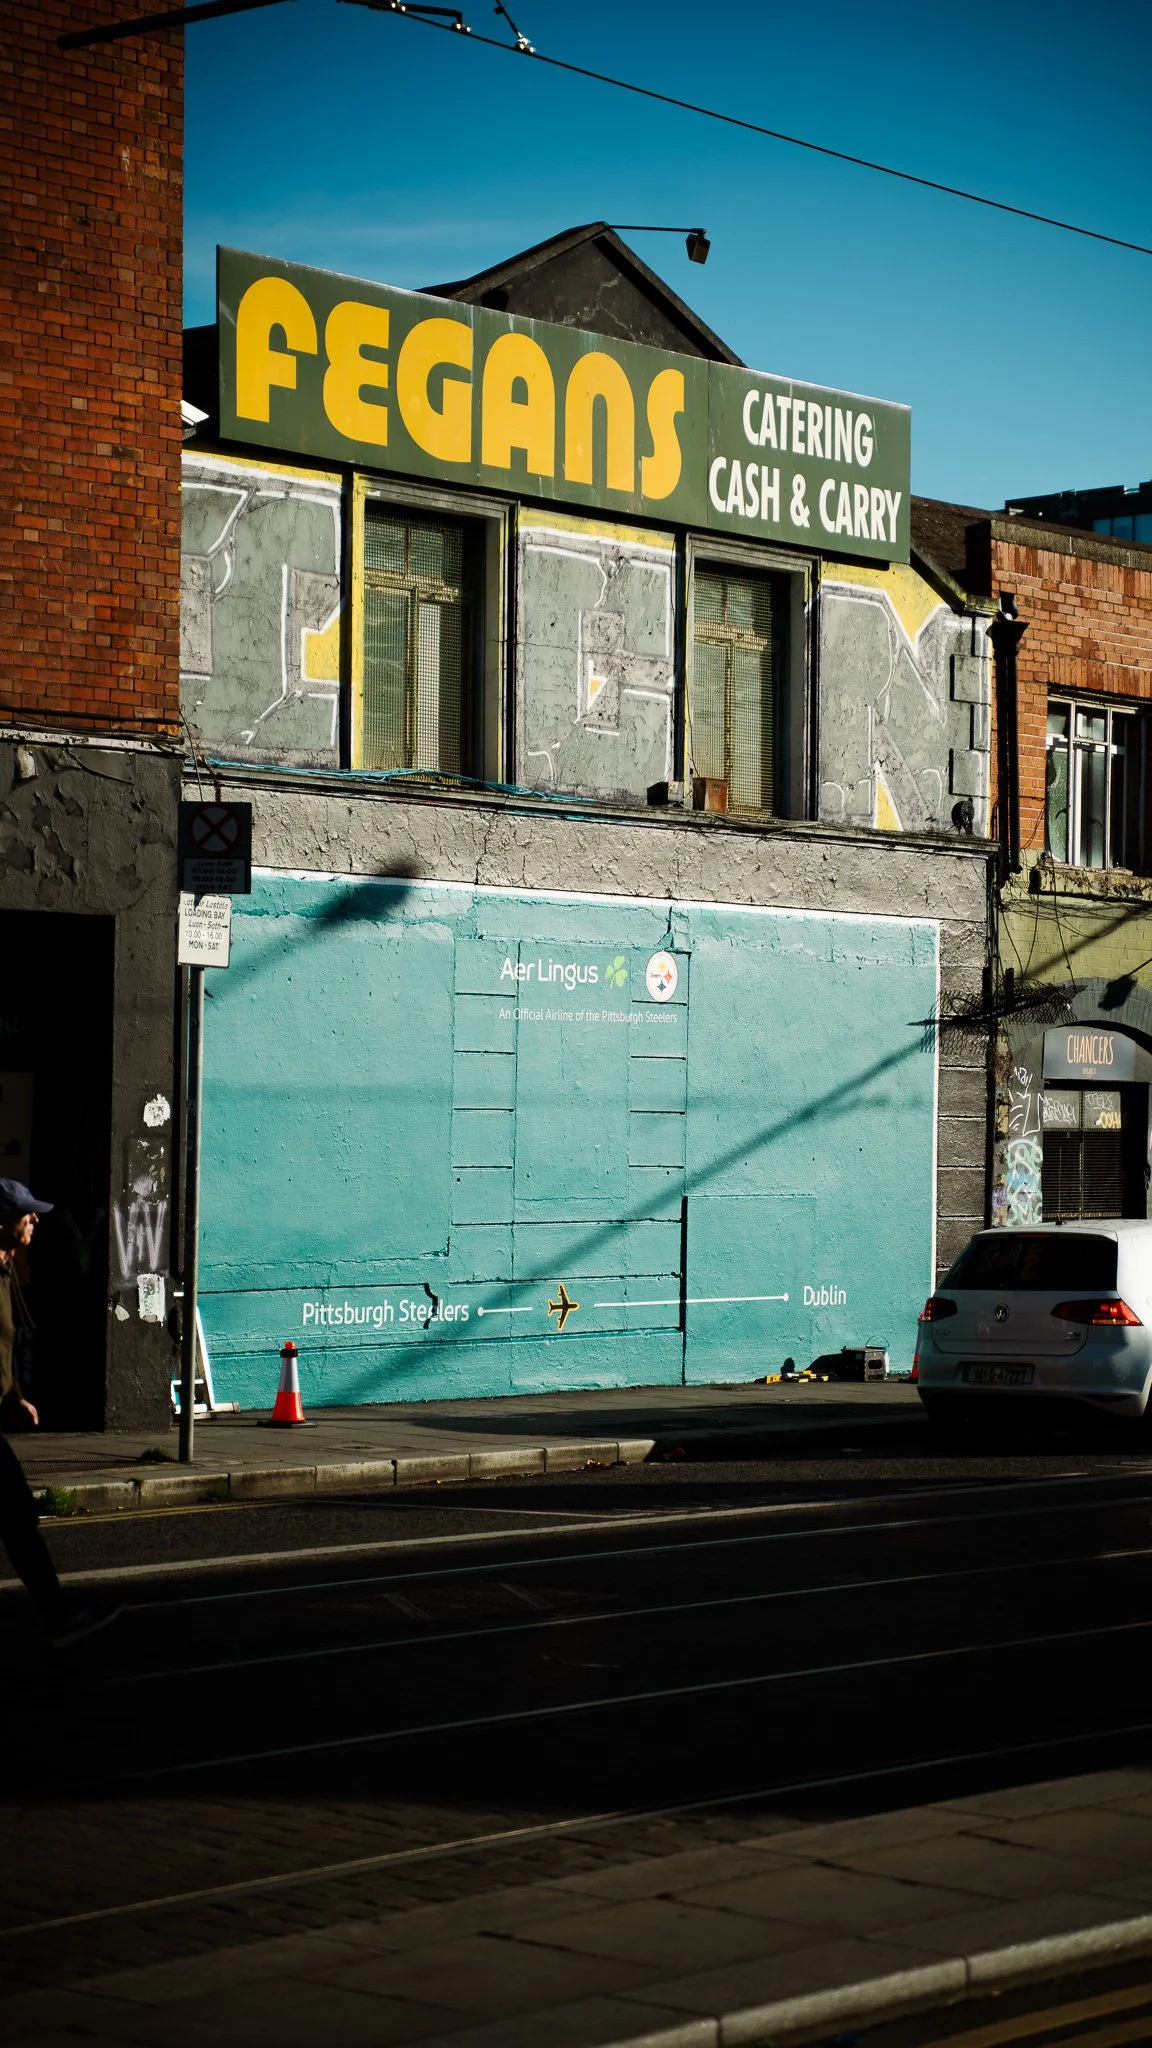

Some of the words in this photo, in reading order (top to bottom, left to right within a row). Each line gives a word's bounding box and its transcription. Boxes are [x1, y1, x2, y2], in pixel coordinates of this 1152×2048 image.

[236, 276, 685, 500] FEGANS
[742, 389, 875, 468] CATERING
[708, 456, 780, 523] CASH
[790, 489, 811, 525] &
[819, 480, 902, 544] CARRY
[184, 908, 212, 919] LOADING
[213, 911, 226, 920] BAY
[500, 957, 536, 981] Aer
[537, 959, 599, 991] Lingus
[499, 1008, 511, 1019] An
[512, 1007, 544, 1021] Official
[546, 1008, 573, 1022] Airline
[575, 1009, 585, 1022] of
[585, 1009, 599, 1022] the
[602, 1010, 643, 1025] Pittsburgh
[645, 1010, 678, 1023] Steelers
[1067, 1034, 1114, 1065] CHANCERS
[803, 1285, 847, 1306] Dublin
[302, 1299, 394, 1329] Pittsburgh
[398, 1298, 469, 1322] Steelers
